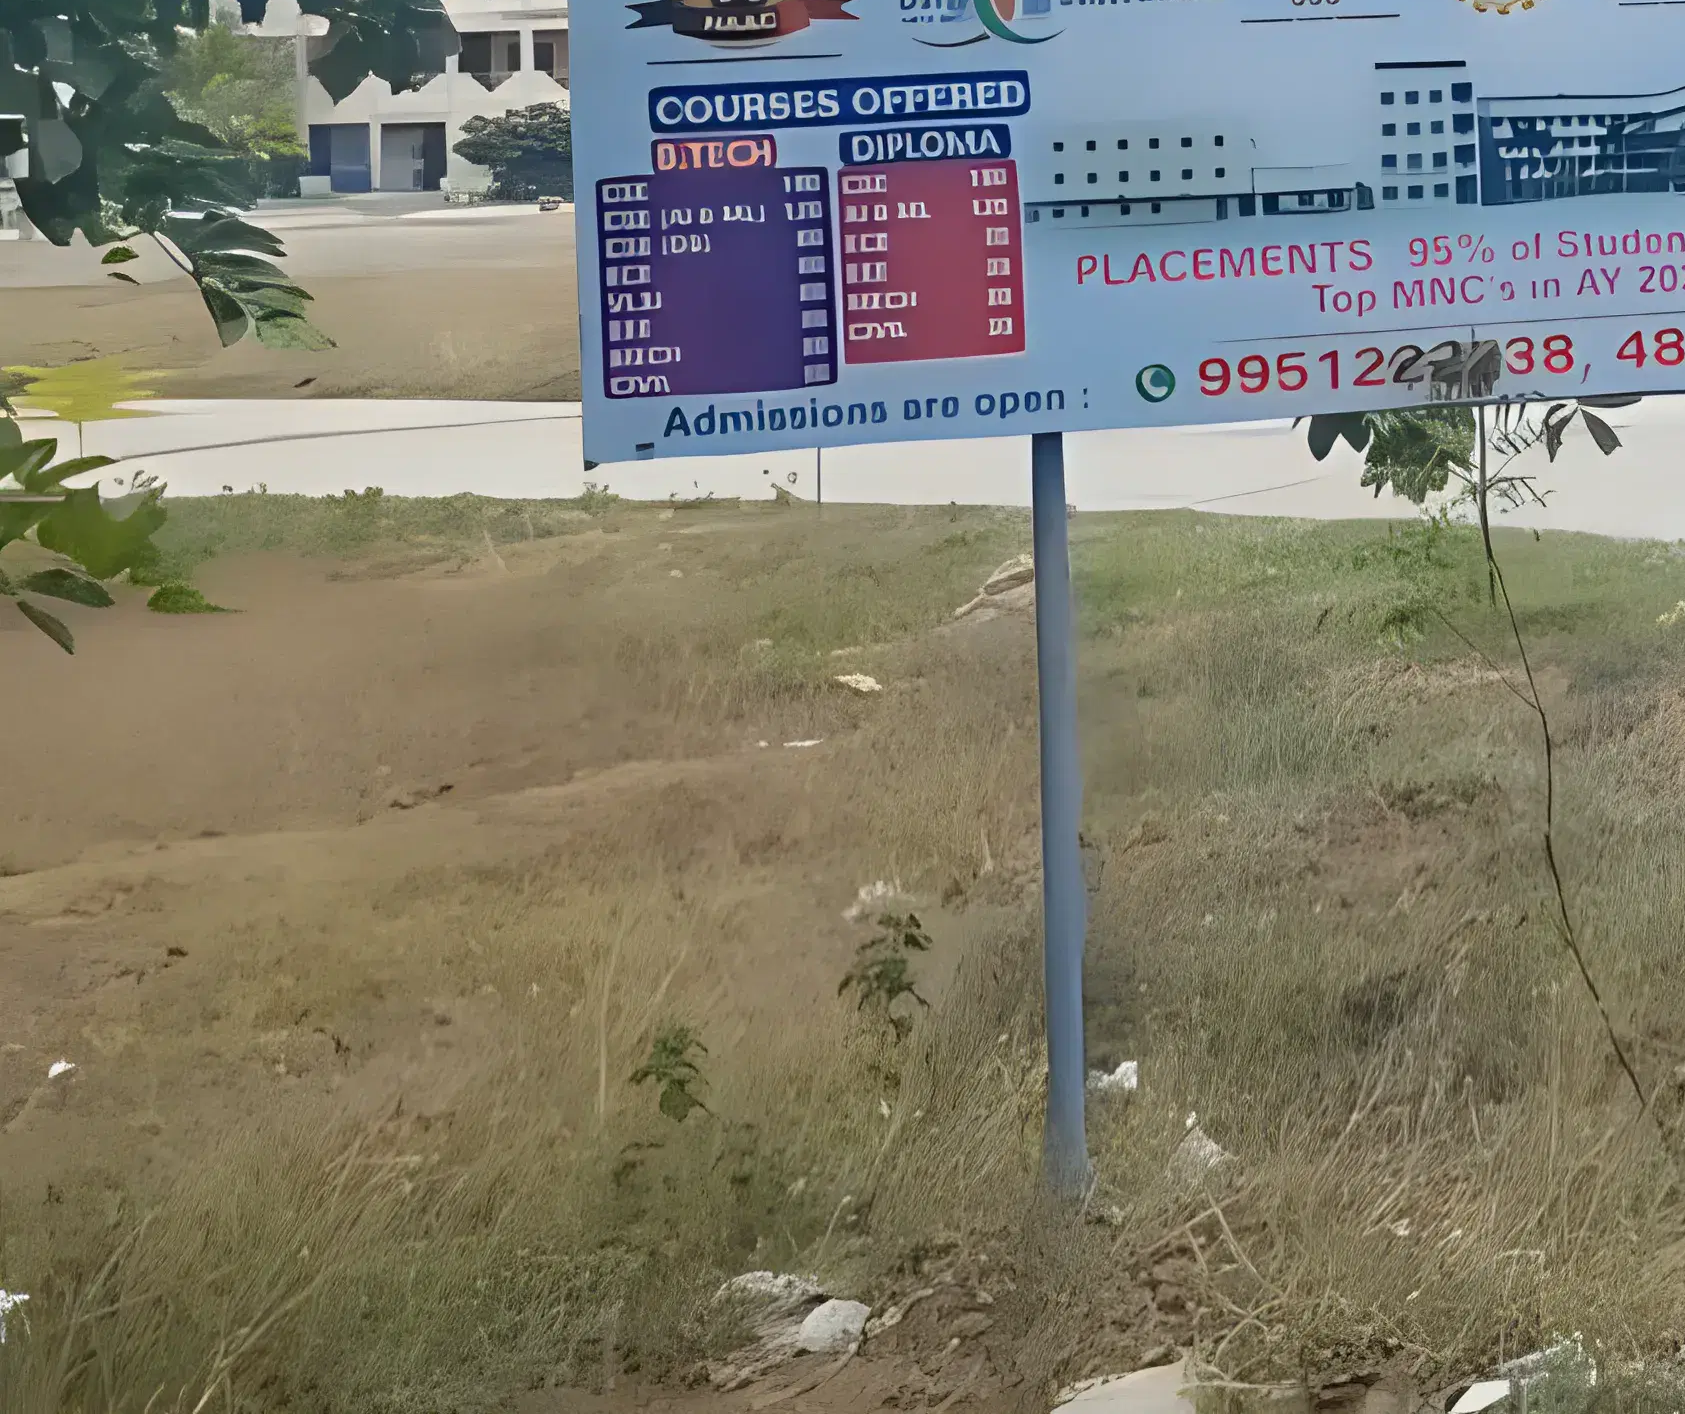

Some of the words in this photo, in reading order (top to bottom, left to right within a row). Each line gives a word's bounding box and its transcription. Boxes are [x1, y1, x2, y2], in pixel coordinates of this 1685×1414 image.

[655, 86, 839, 126] COURSES
[851, 128, 1002, 161] DIPLOMA
[1076, 239, 1374, 286] PLACEMENTS
[1408, 234, 1495, 268] 95%
[1312, 283, 1377, 317] Top
[1531, 276, 1561, 300] in
[1576, 266, 1621, 297] AY
[975, 389, 1066, 419] open
